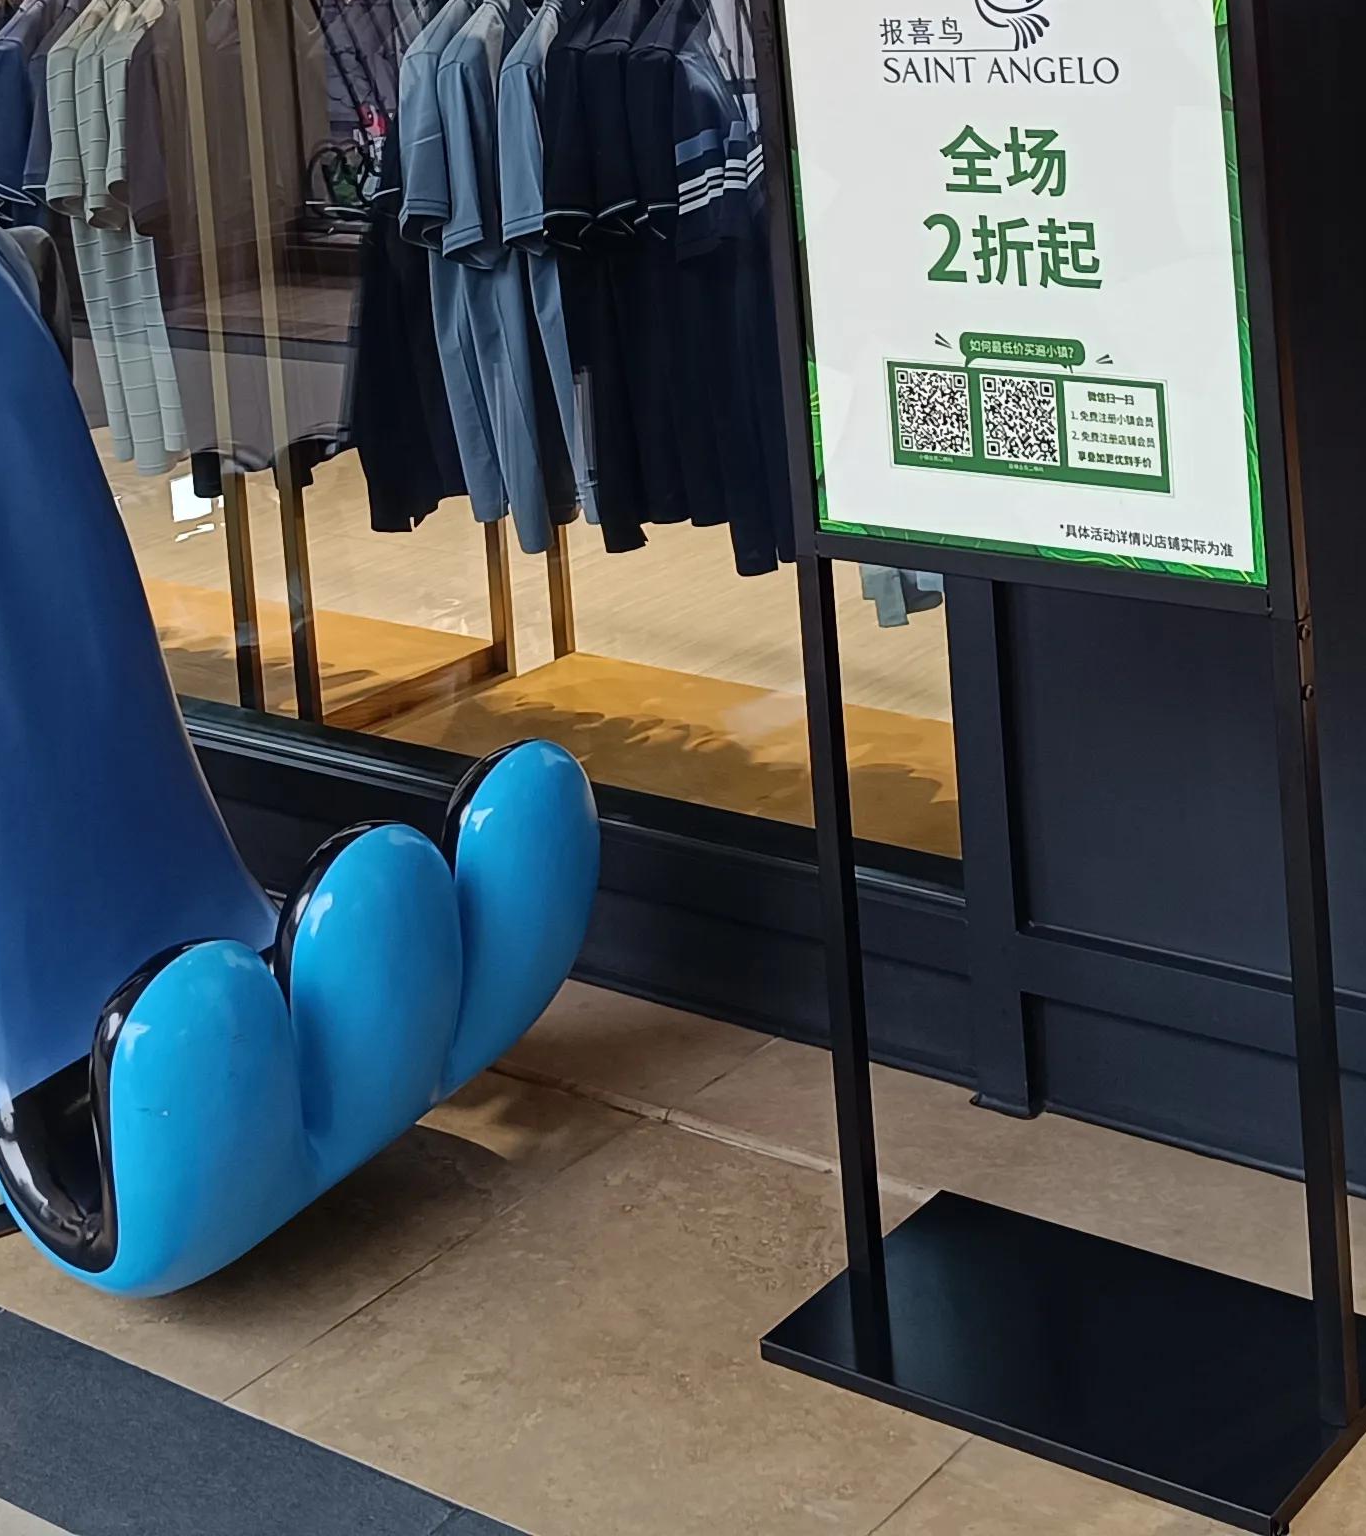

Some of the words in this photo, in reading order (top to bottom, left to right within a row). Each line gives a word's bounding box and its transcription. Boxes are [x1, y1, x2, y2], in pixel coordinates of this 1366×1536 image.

[879, 17, 963, 46] 报喜鸟
[883, 57, 977, 83] SAINT
[987, 56, 1120, 84] ANGELO
[939, 124, 1067, 197] 全场
[923, 213, 1103, 290] 2折起
